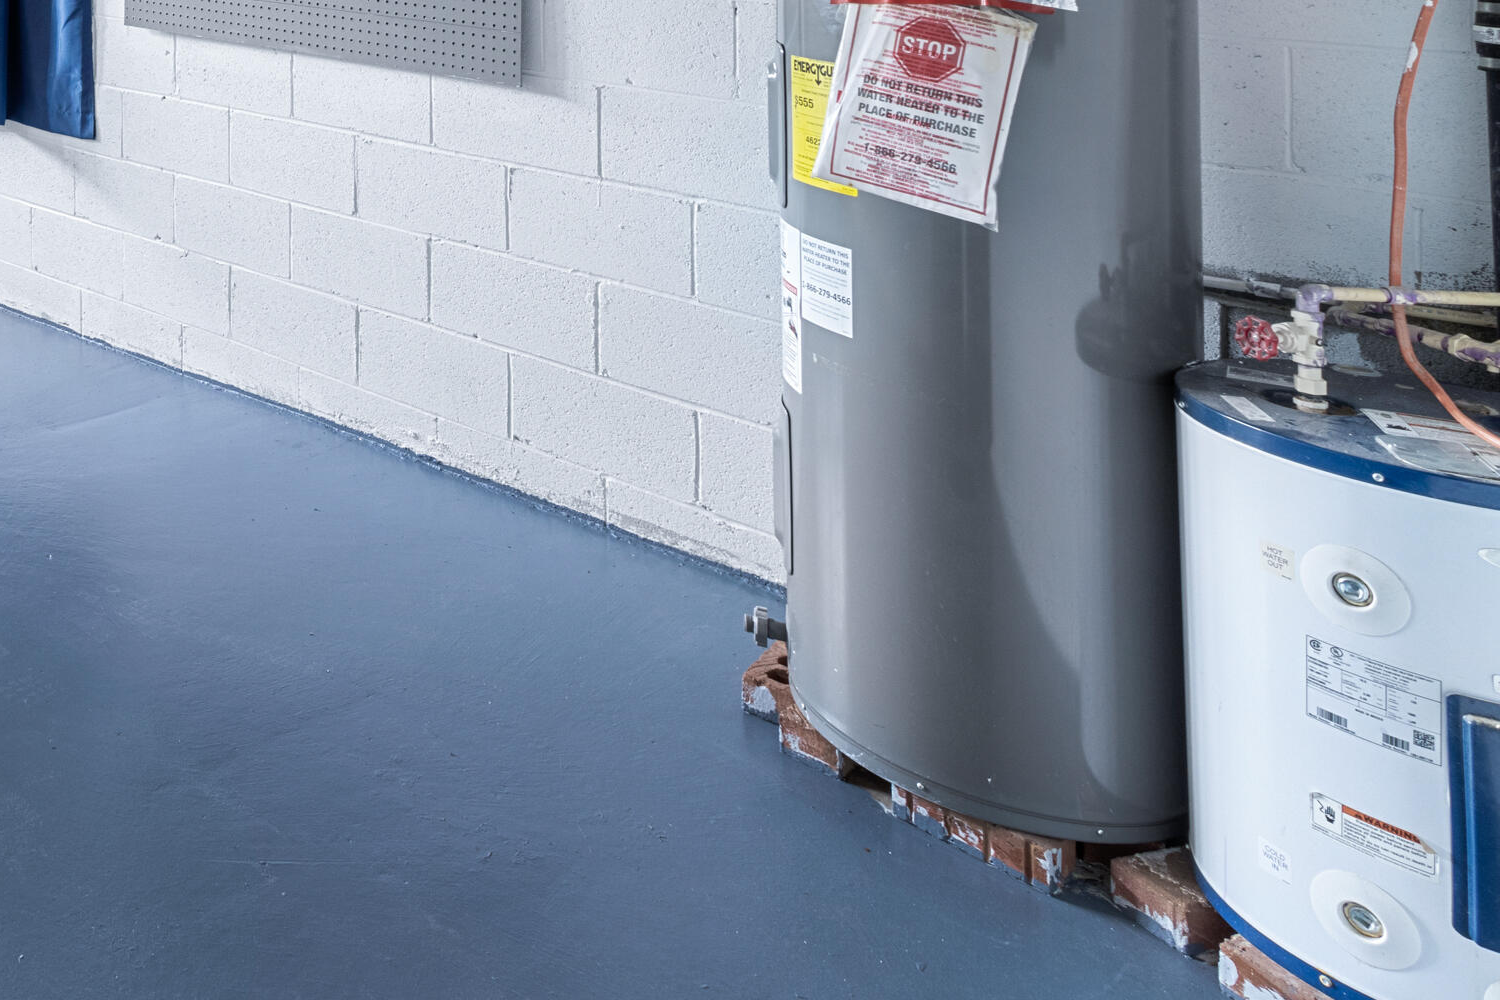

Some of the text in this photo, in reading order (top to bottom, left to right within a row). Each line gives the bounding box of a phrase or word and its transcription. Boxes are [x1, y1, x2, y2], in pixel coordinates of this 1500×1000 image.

[902, 35, 957, 61] STOP
[793, 59, 835, 79] ENERGYGU
[863, 74, 983, 108] DO NOT RETURN THIS
[857, 87, 985, 124] WATER HEATER TO THE
[858, 102, 892, 118] PLACE
[895, 111, 911, 122] OF
[913, 115, 978, 138] PURCHASE
[837, 250, 849, 259] THIS
[1262, 550, 1289, 566] WATER
[1266, 545, 1283, 556] HOT
[1267, 559, 1283, 570] OUT
